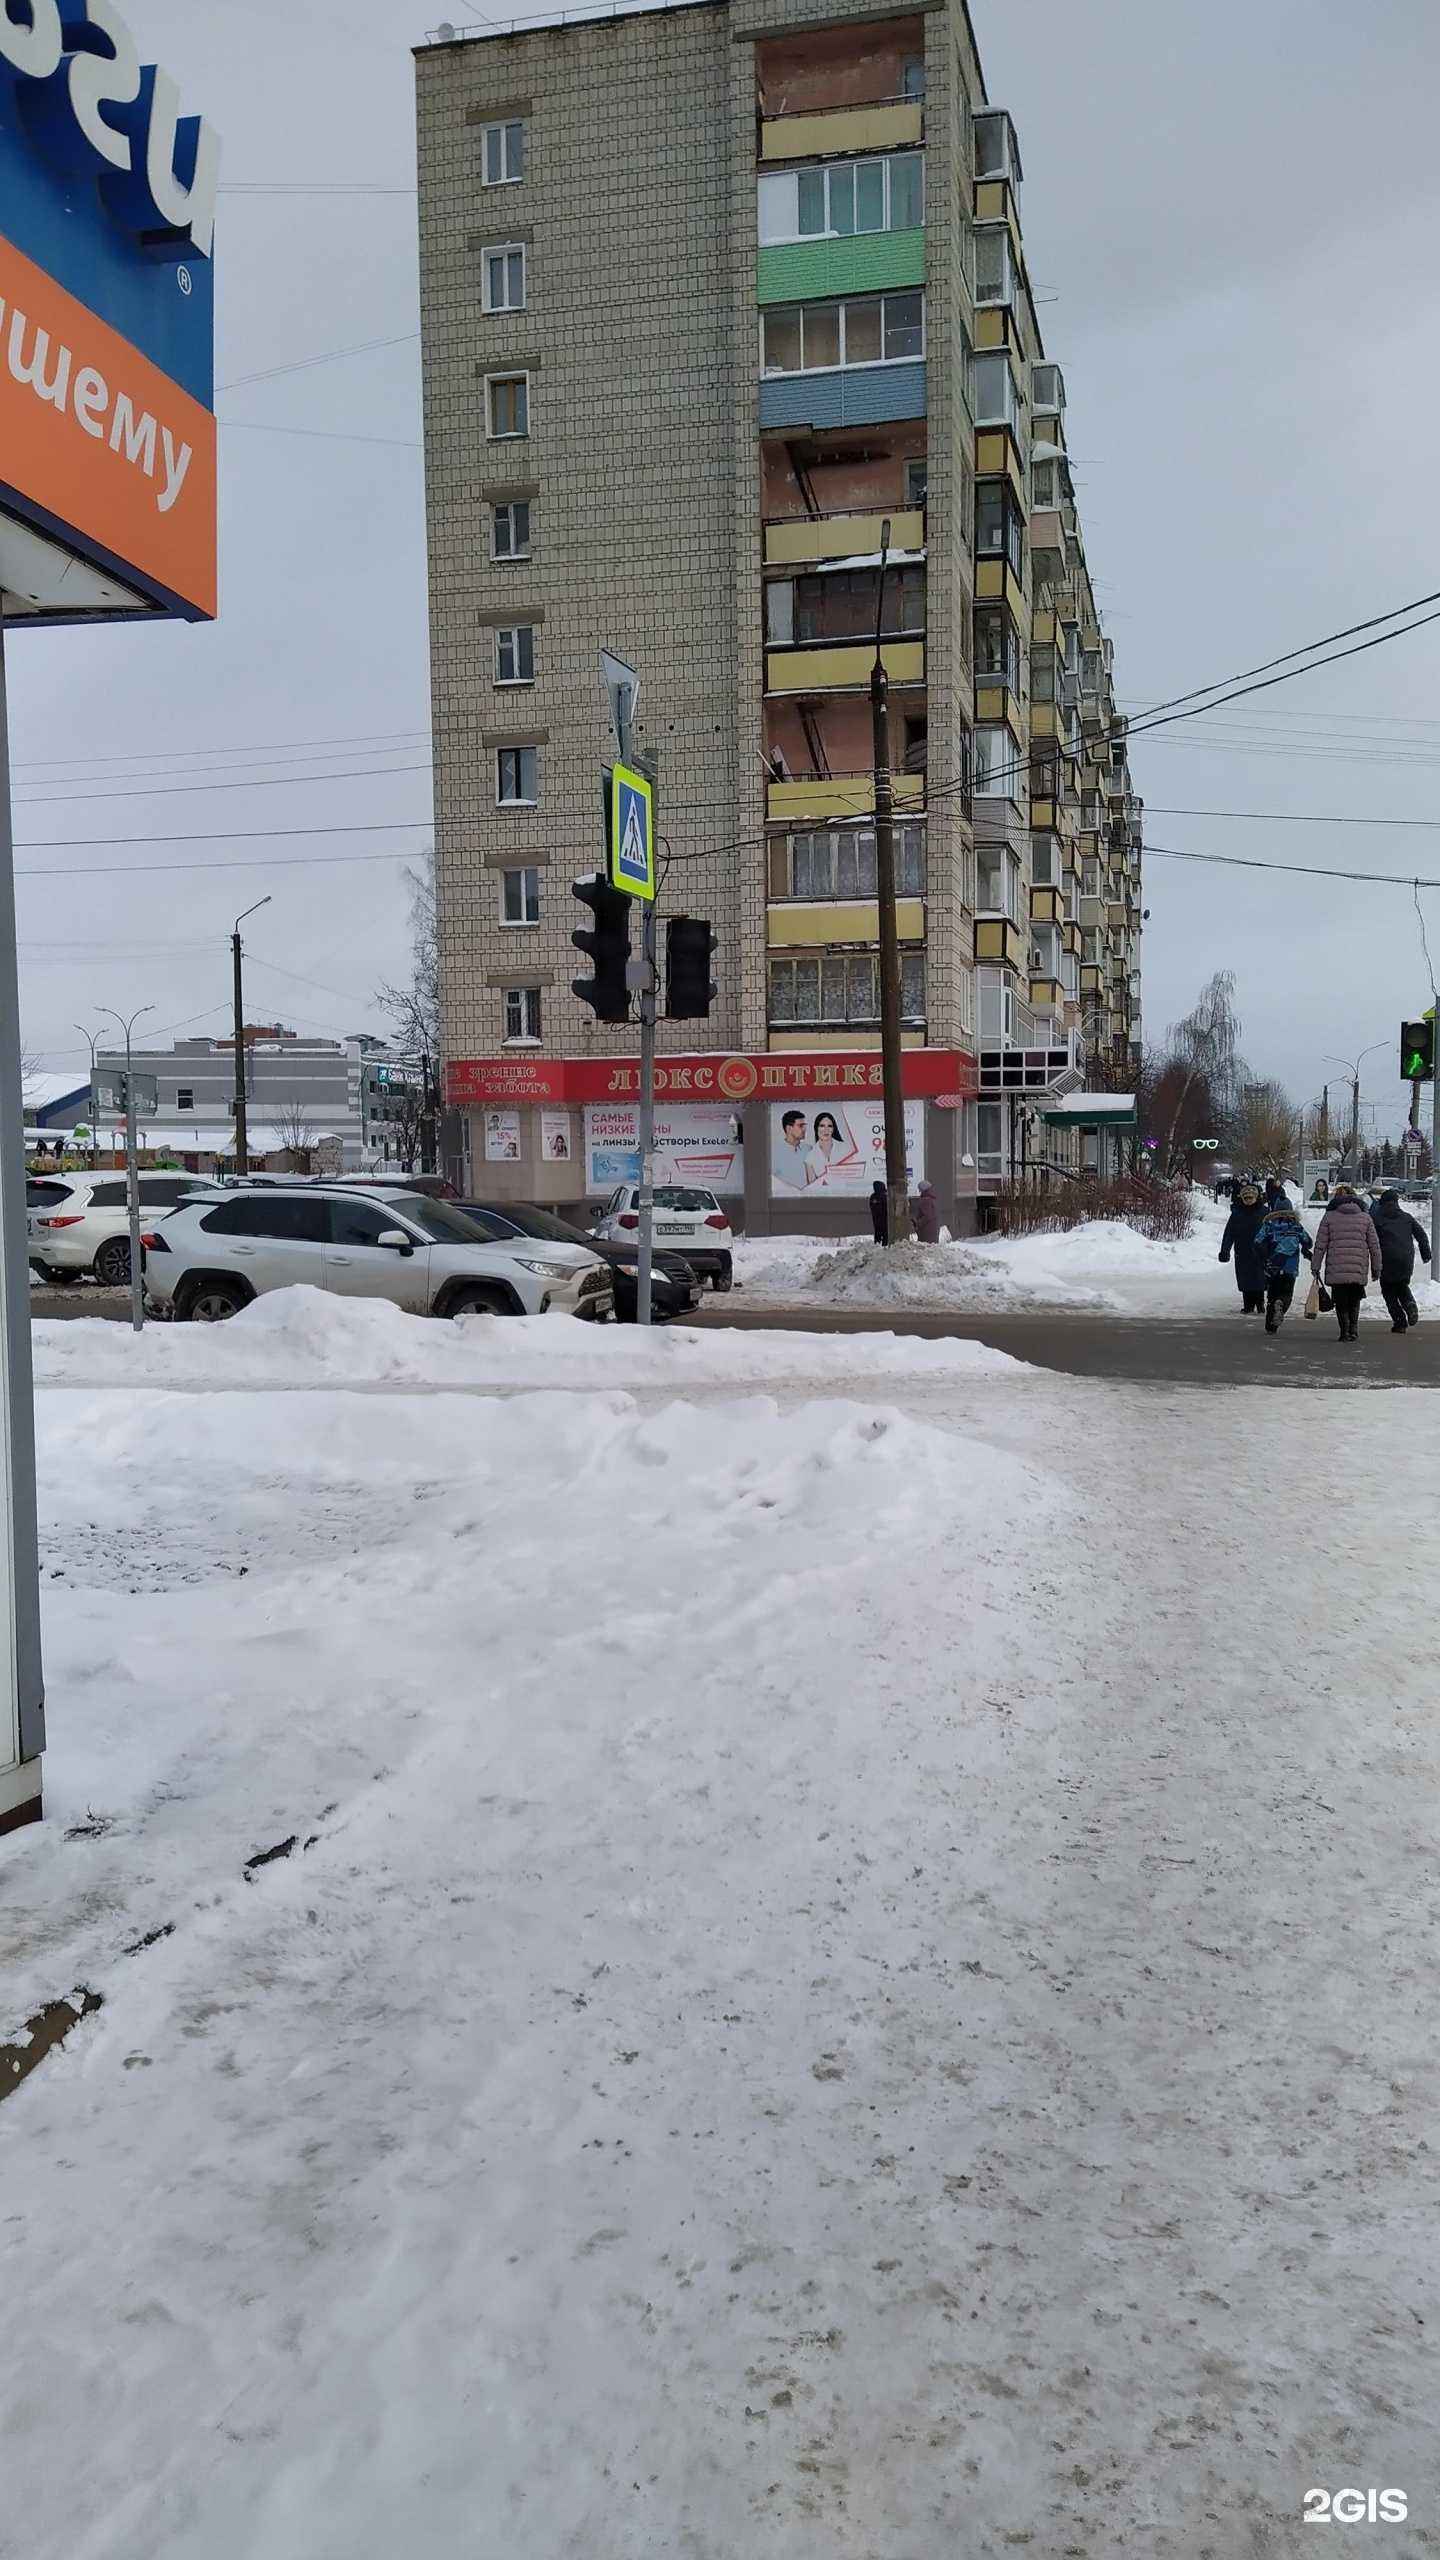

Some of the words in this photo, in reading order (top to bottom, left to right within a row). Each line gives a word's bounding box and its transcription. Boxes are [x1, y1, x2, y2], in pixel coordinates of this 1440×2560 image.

[0, 297, 193, 512] шему
[591, 1113, 634, 1123] САМЫЕ
[591, 1125, 636, 1135] НИЗКИЕ
[602, 1138, 636, 1146] линзы
[655, 1138, 700, 1147] створы
